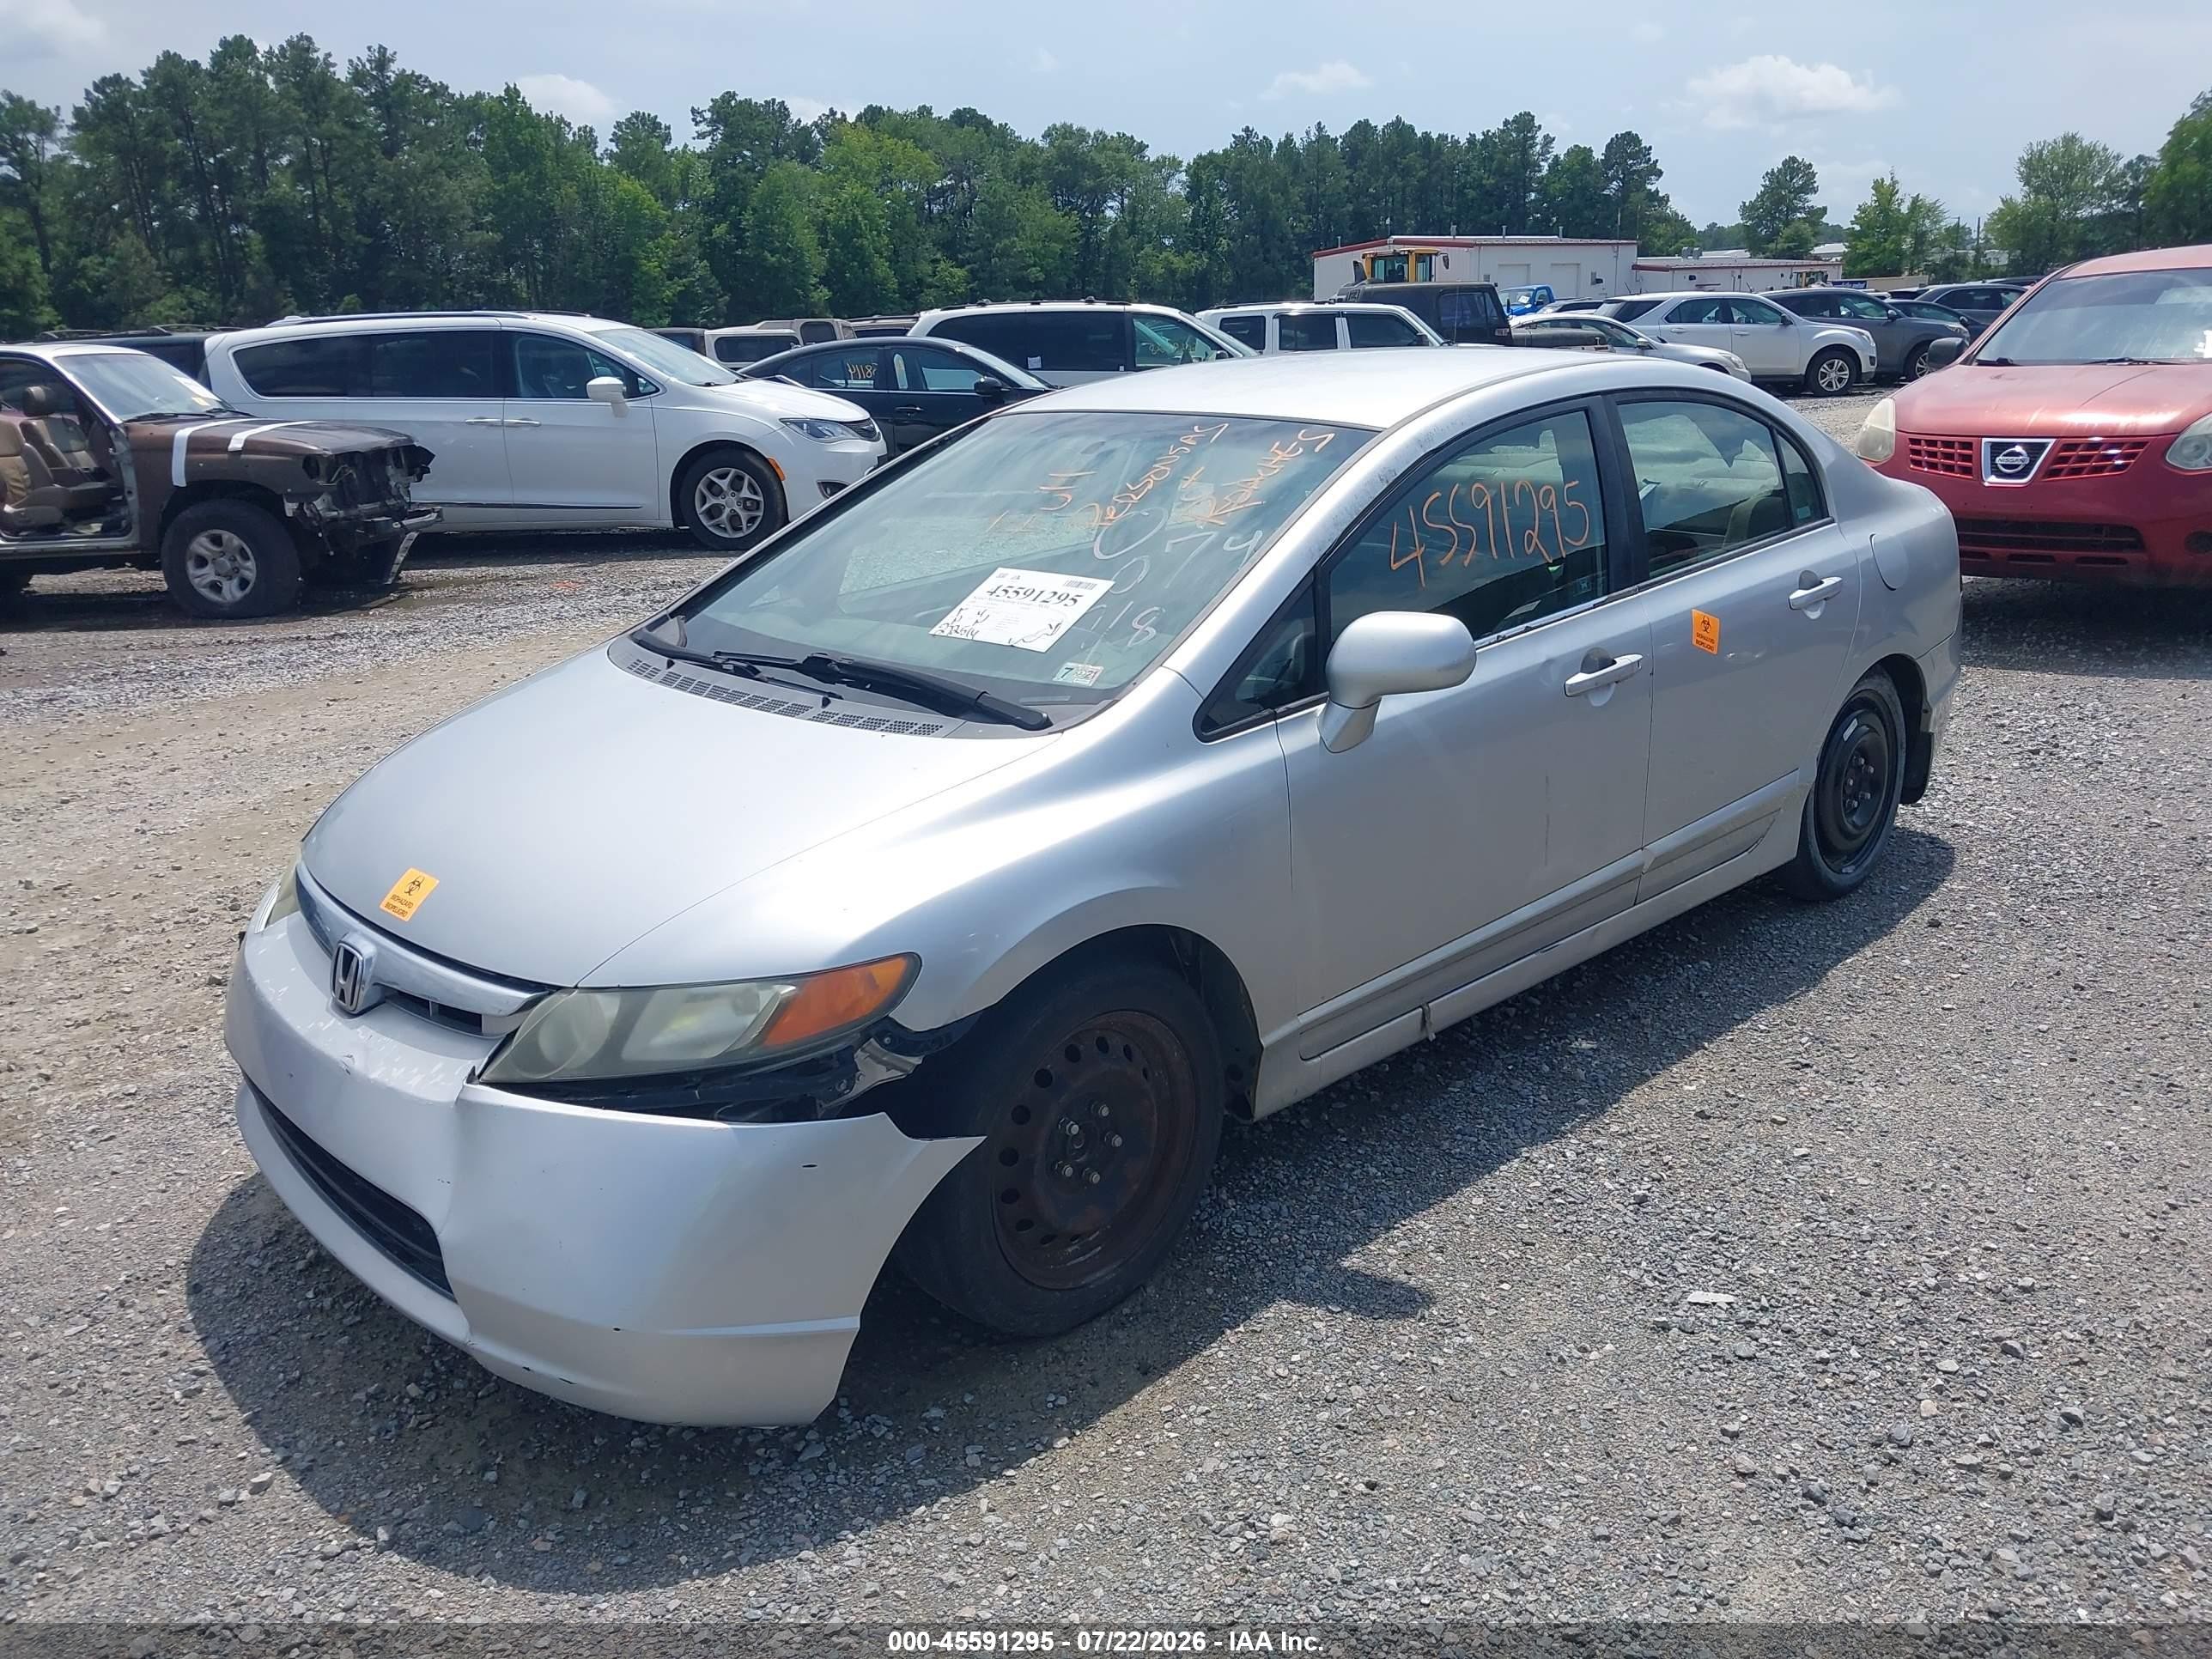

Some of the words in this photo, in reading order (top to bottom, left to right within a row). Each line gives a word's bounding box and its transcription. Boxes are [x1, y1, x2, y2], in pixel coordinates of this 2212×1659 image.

[1389, 480, 1590, 589] 45591295
[986, 583, 1085, 608] 45591295
[1060, 666, 1074, 678] 7
